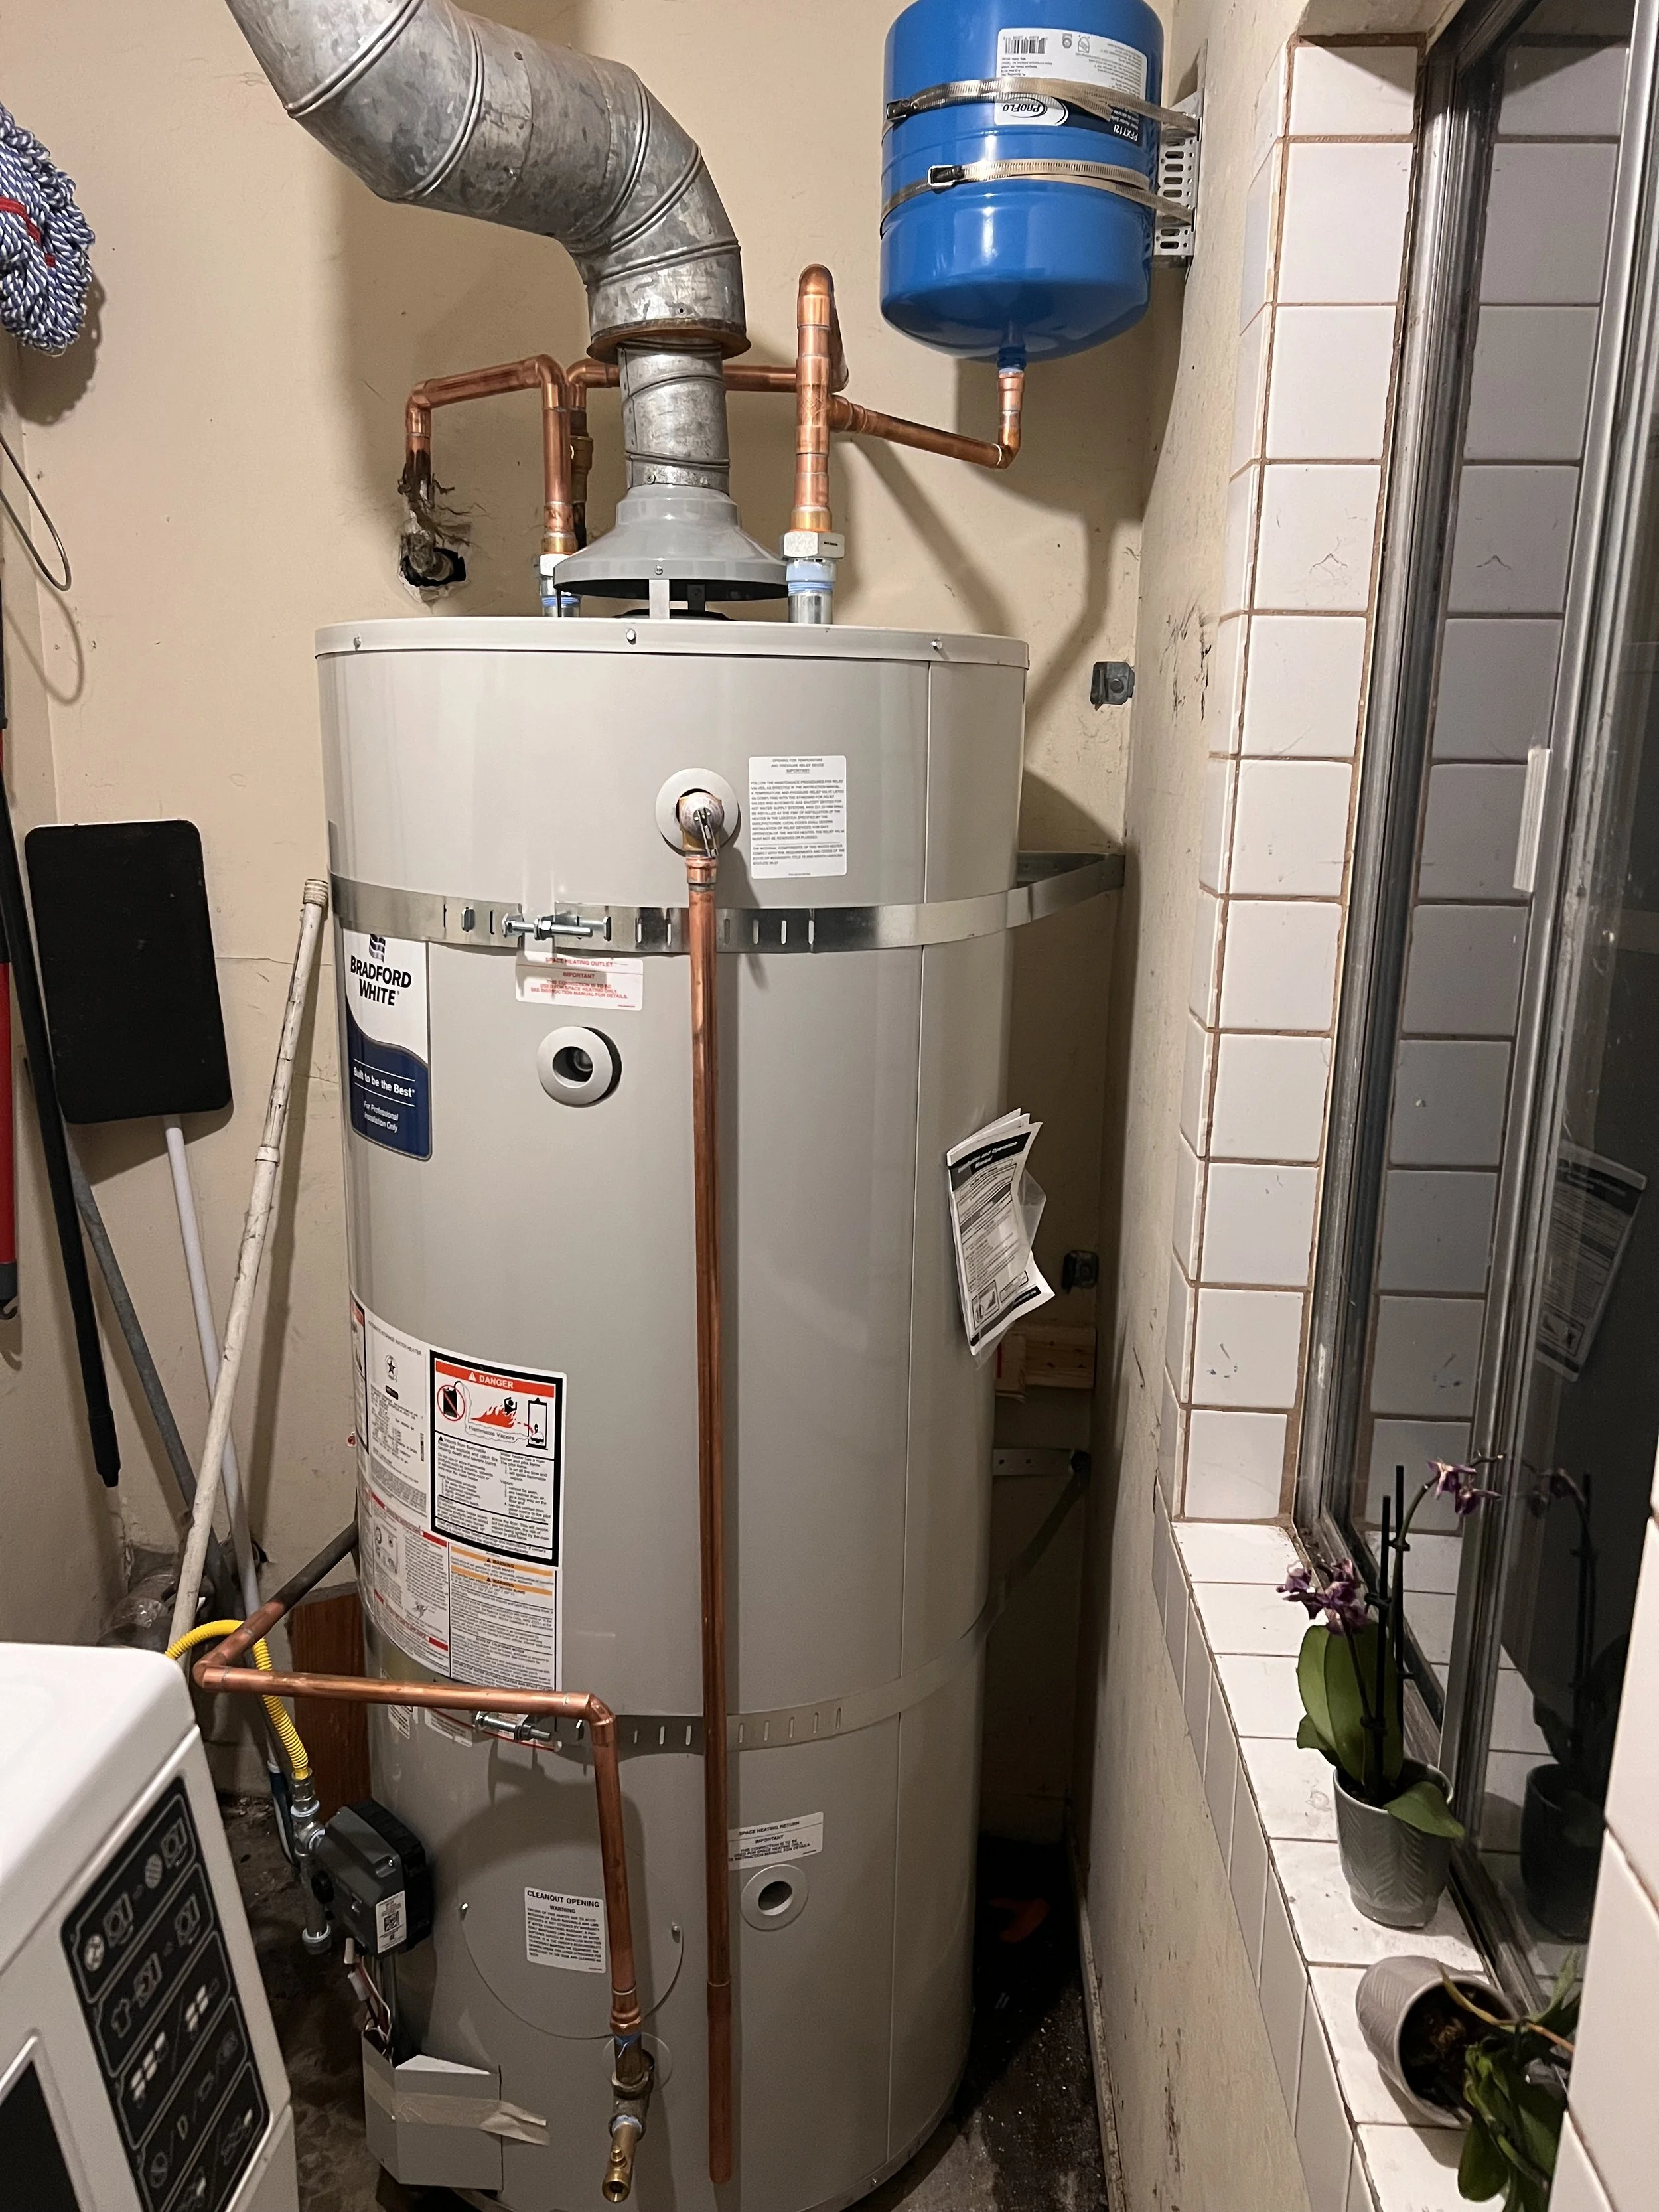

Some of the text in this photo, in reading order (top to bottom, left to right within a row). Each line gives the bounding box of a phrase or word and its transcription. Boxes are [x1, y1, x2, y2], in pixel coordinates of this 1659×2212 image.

[350, 955, 411, 988] BRADFORD
[364, 1072, 370, 1083] to
[372, 1075, 380, 1086] be
[381, 1080, 392, 1091] the
[371, 1104, 399, 1120] Professional
[387, 1122, 397, 1133] Only
[479, 1375, 514, 1389] DANGER
[469, 1426, 514, 1440] Flammable Vapors
[492, 1560, 514, 1568] WARNING
[492, 1579, 514, 1587] WARNING
[755, 1834, 783, 1844] IMPORTANT
[528, 1890, 599, 1908] CLEANOUT OPENING
[550, 1905, 575, 1913] WARNING
